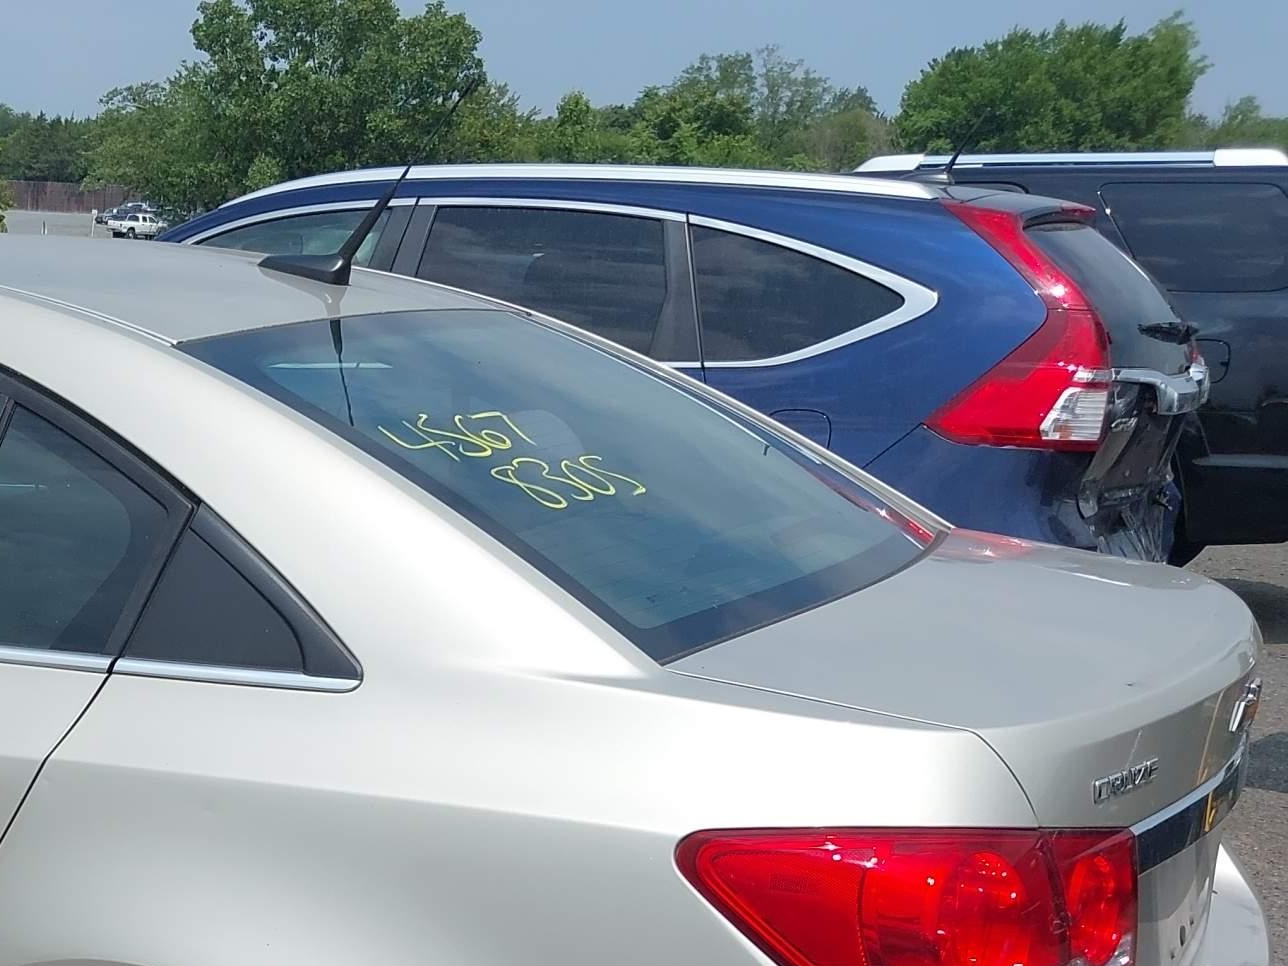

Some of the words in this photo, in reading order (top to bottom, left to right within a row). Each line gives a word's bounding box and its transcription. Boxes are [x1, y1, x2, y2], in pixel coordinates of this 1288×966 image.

[377, 411, 537, 462] 4567
[490, 455, 647, 509] 8305
[1093, 757, 1160, 804] CRUZE
